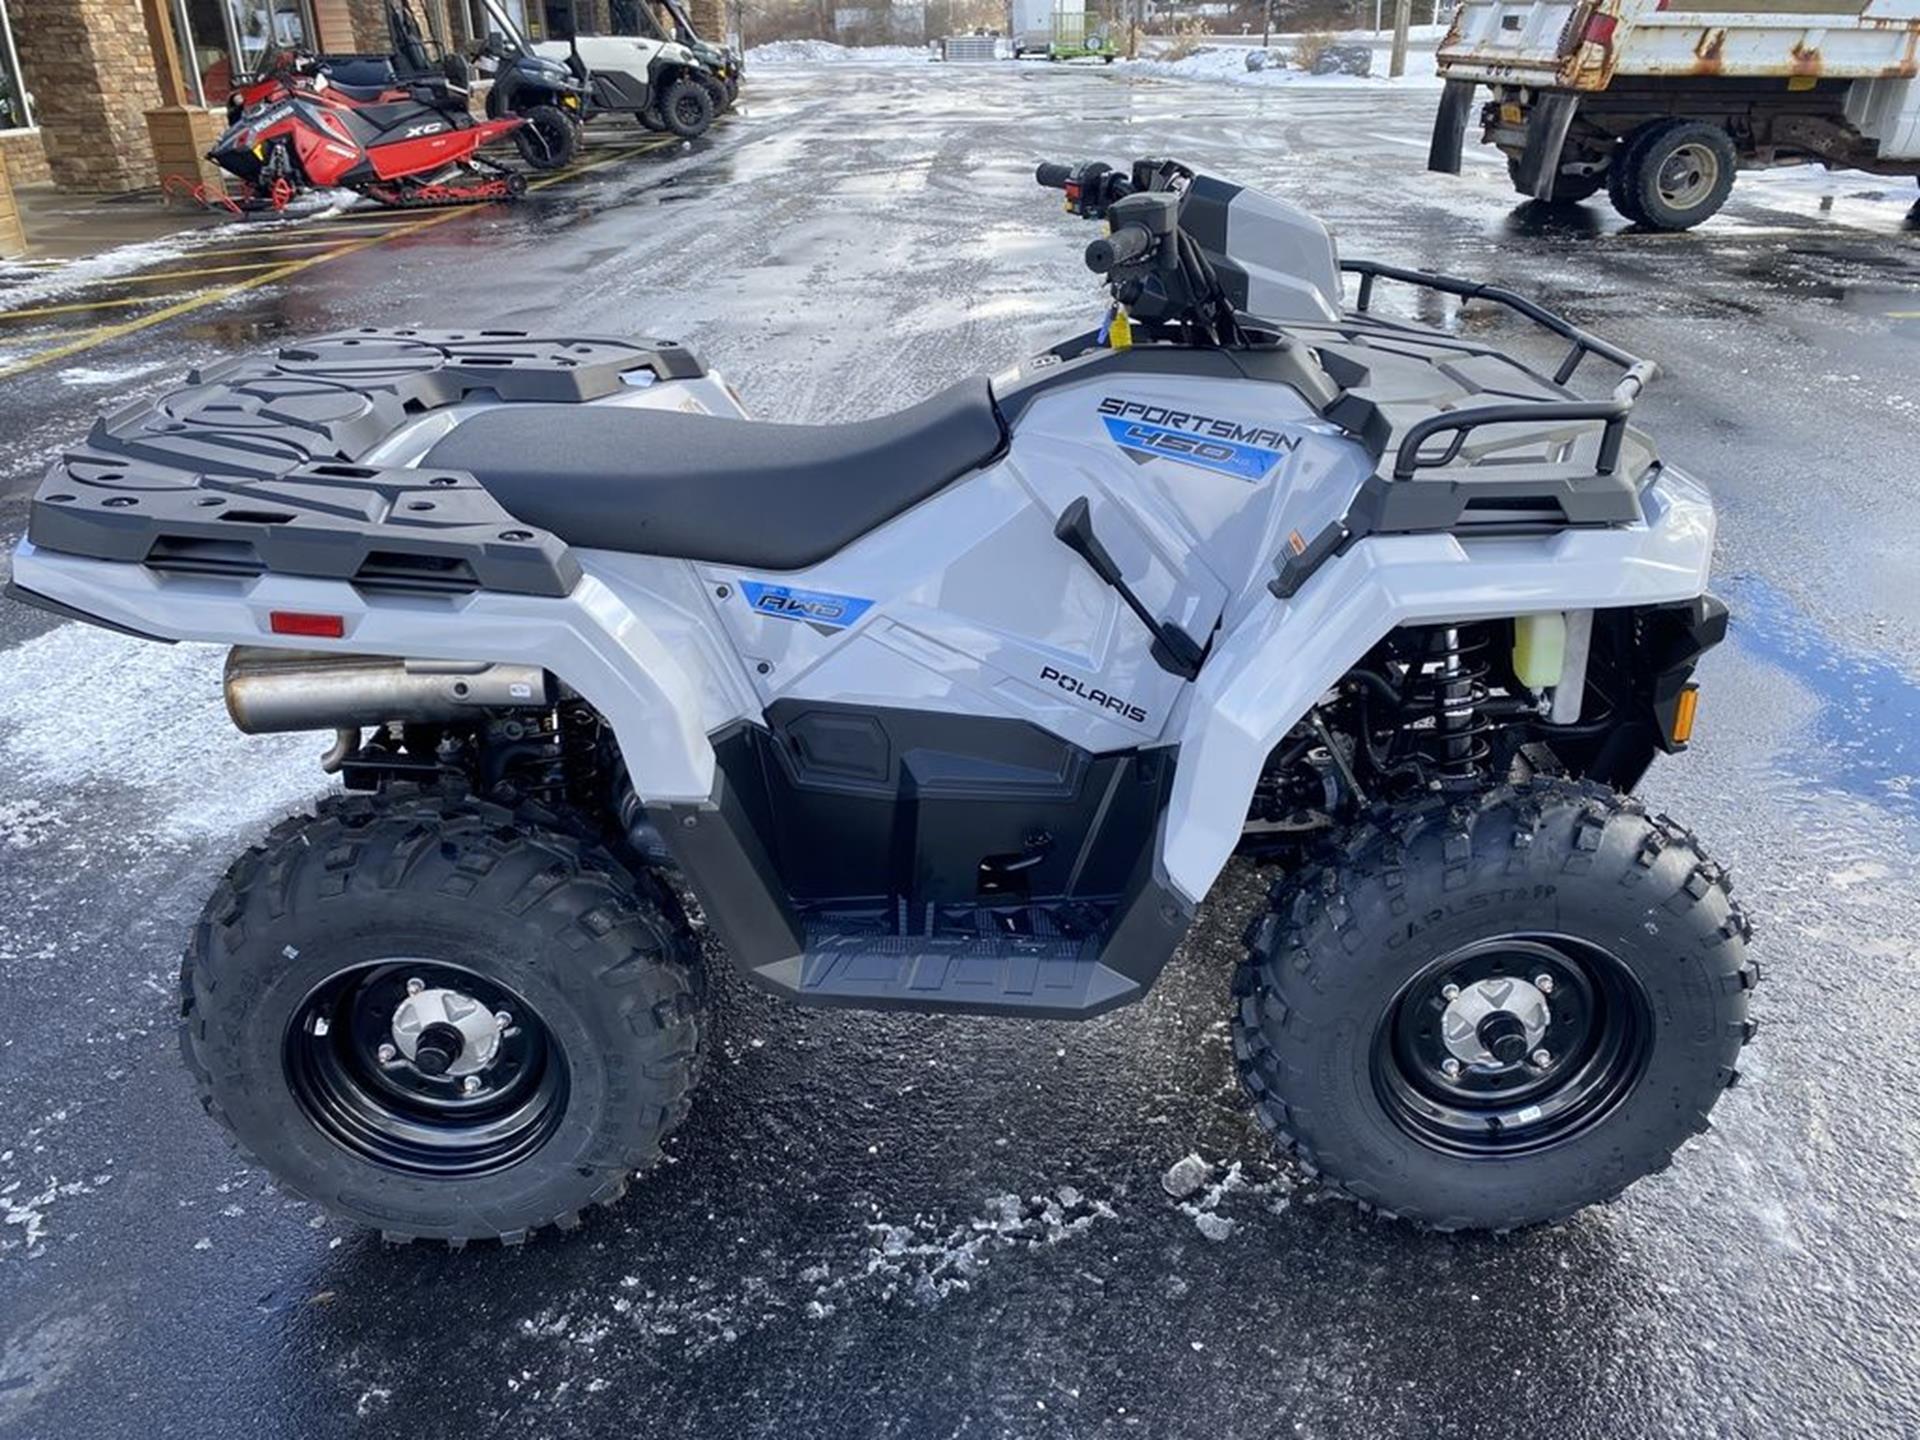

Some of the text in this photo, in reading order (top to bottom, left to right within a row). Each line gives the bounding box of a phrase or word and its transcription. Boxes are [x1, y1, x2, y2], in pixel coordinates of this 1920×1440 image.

[405, 122, 442, 139] XC
[1097, 397, 1303, 452] SPORTSMAN
[1126, 425, 1235, 464] 450
[757, 594, 844, 618] AWD
[1040, 665, 1148, 723] POLARIS
